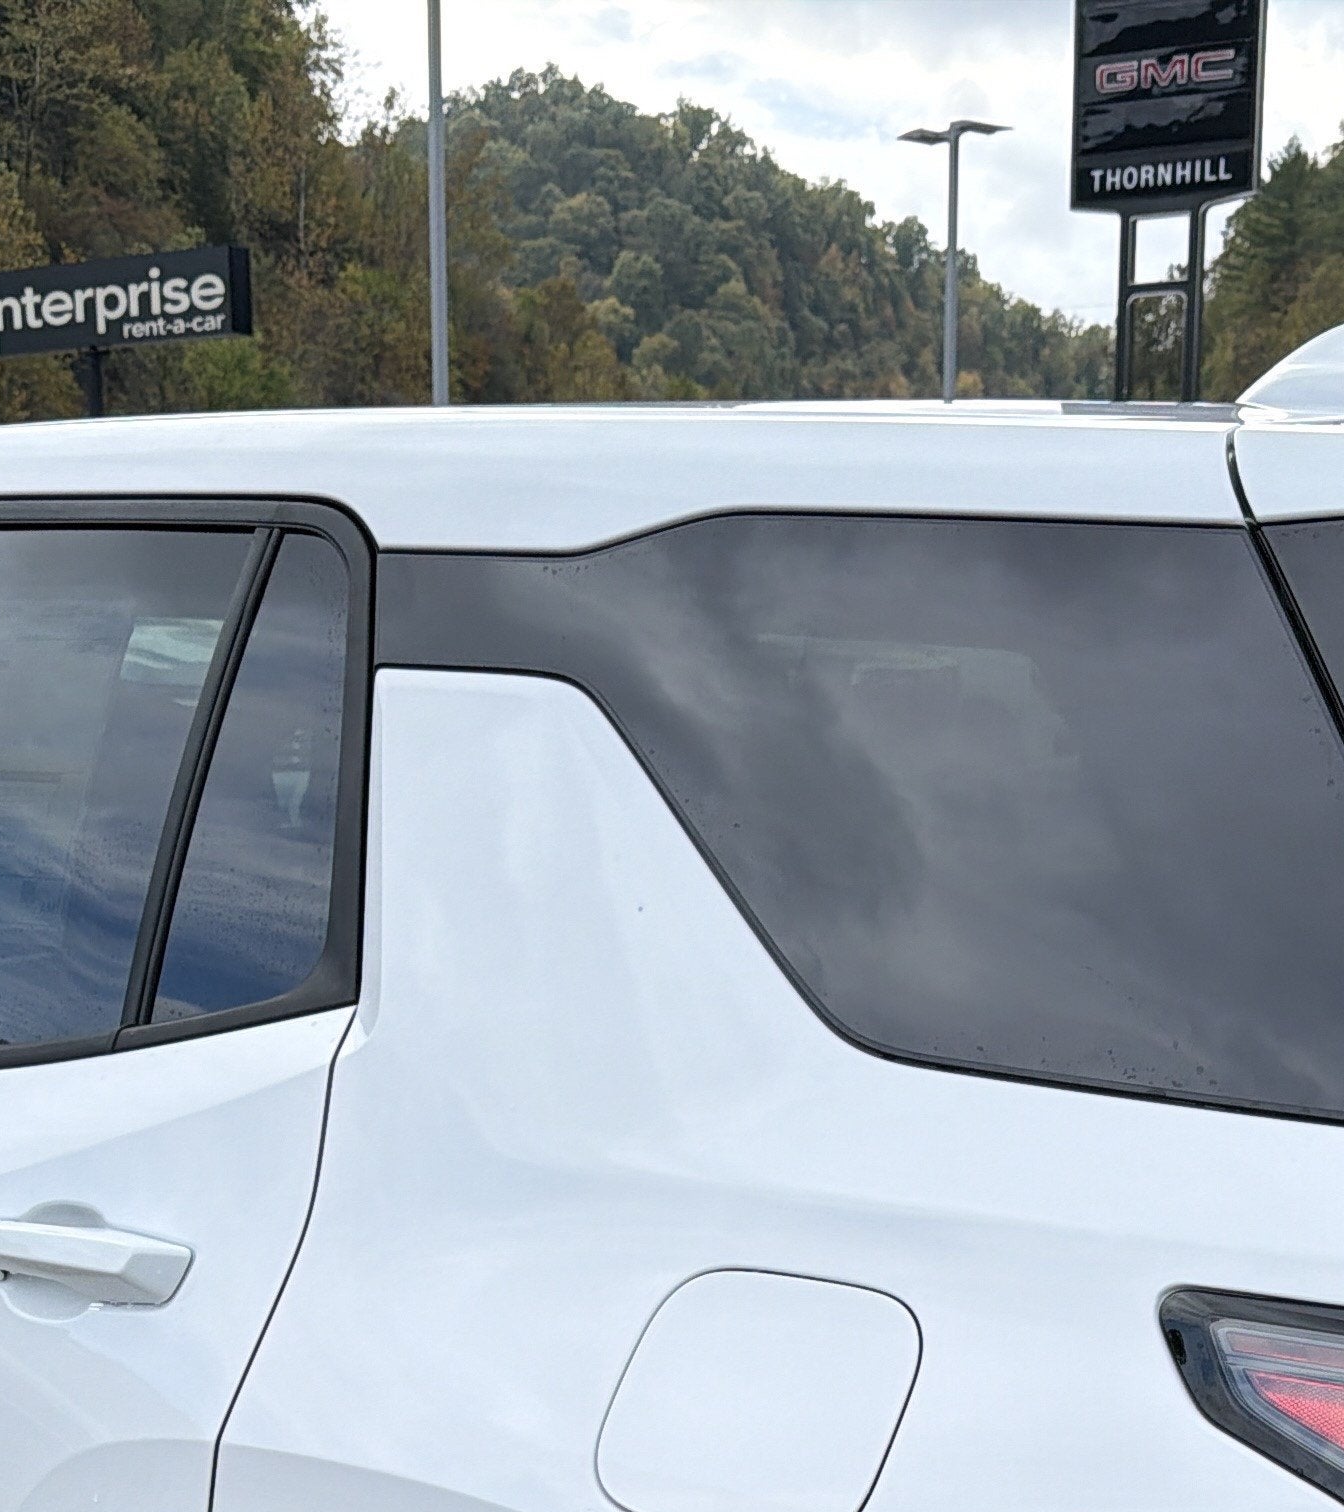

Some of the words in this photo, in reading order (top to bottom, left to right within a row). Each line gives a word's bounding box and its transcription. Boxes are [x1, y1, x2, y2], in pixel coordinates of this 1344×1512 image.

[1095, 49, 1235, 94] GMC
[1090, 156, 1233, 193] THORNHILL
[122, 313, 226, 339] rent-a-car
